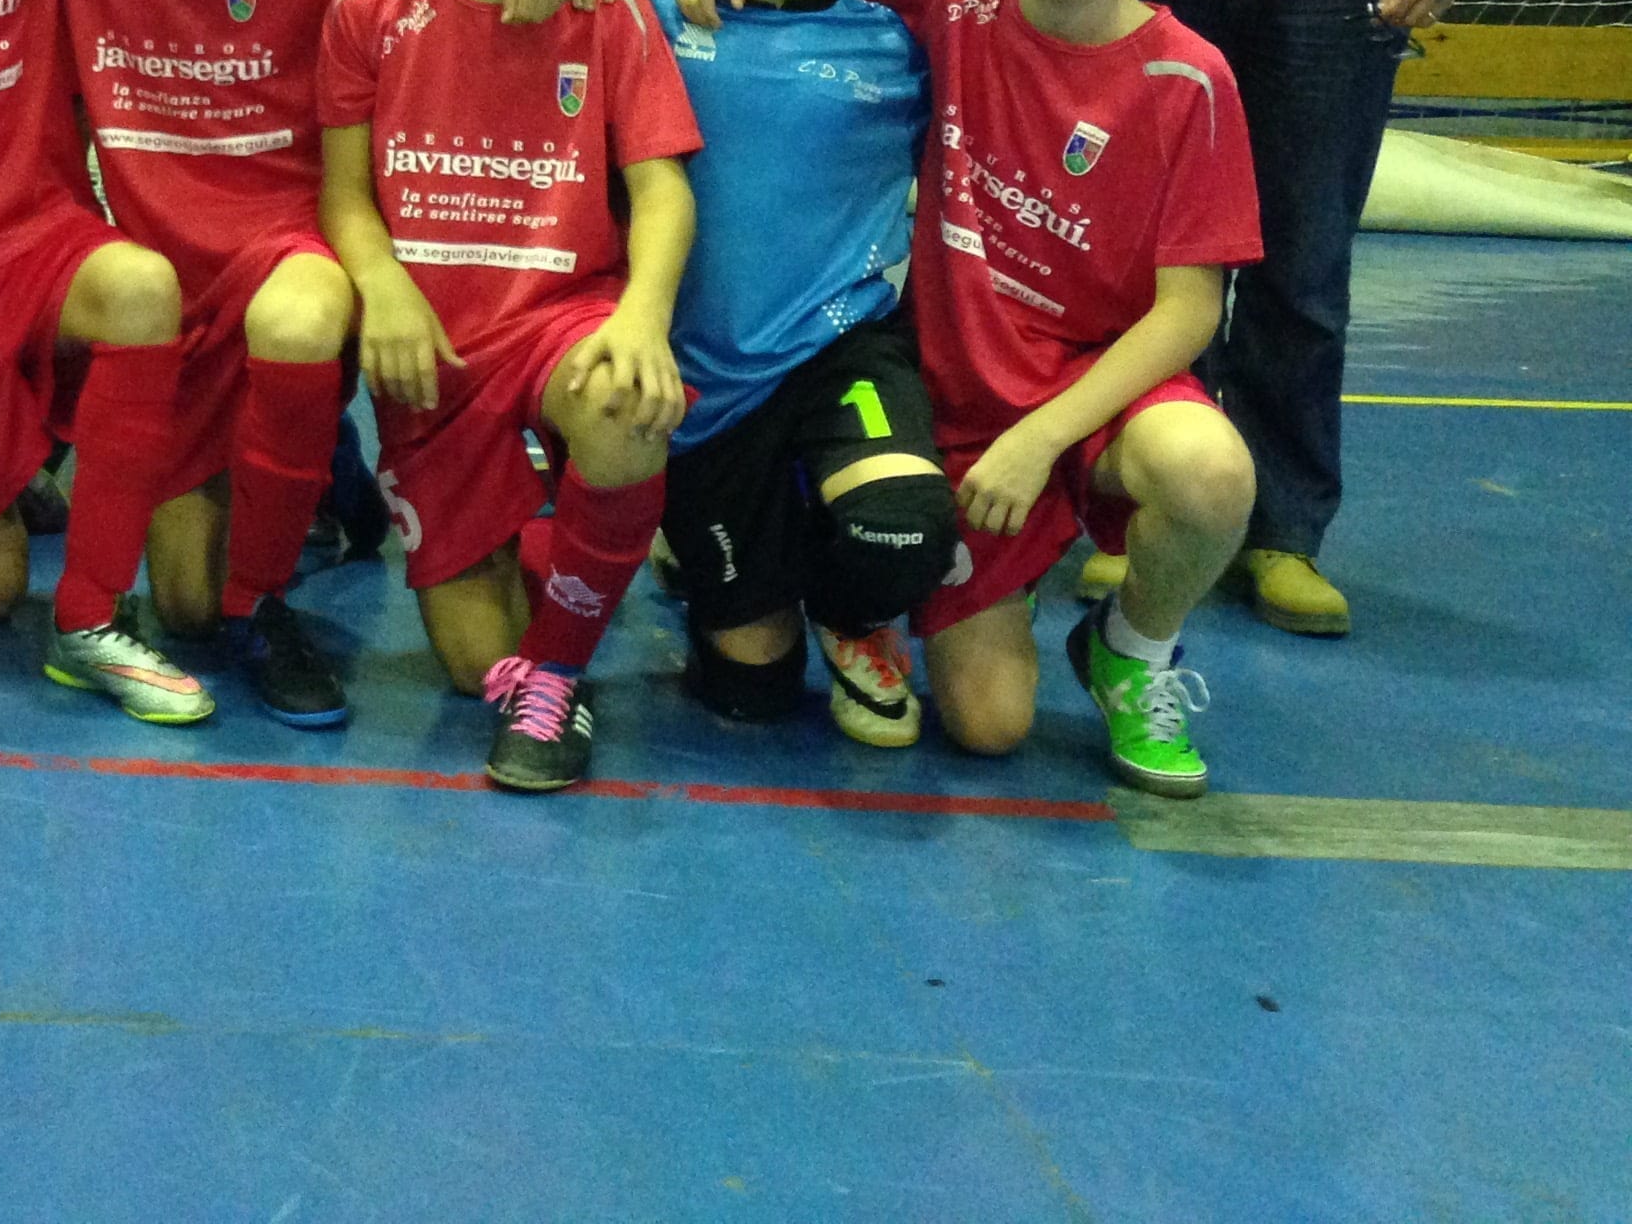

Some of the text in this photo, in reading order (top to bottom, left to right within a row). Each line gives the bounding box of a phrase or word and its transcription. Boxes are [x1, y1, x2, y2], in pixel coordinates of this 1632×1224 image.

[112, 82, 130, 97] la
[113, 96, 133, 111] de
[204, 103, 265, 121] seguro
[401, 187, 524, 210] la confianza
[400, 204, 423, 219] de
[429, 208, 507, 225] sentirse
[840, 380, 893, 439] 1
[850, 523, 924, 549] Kempa
